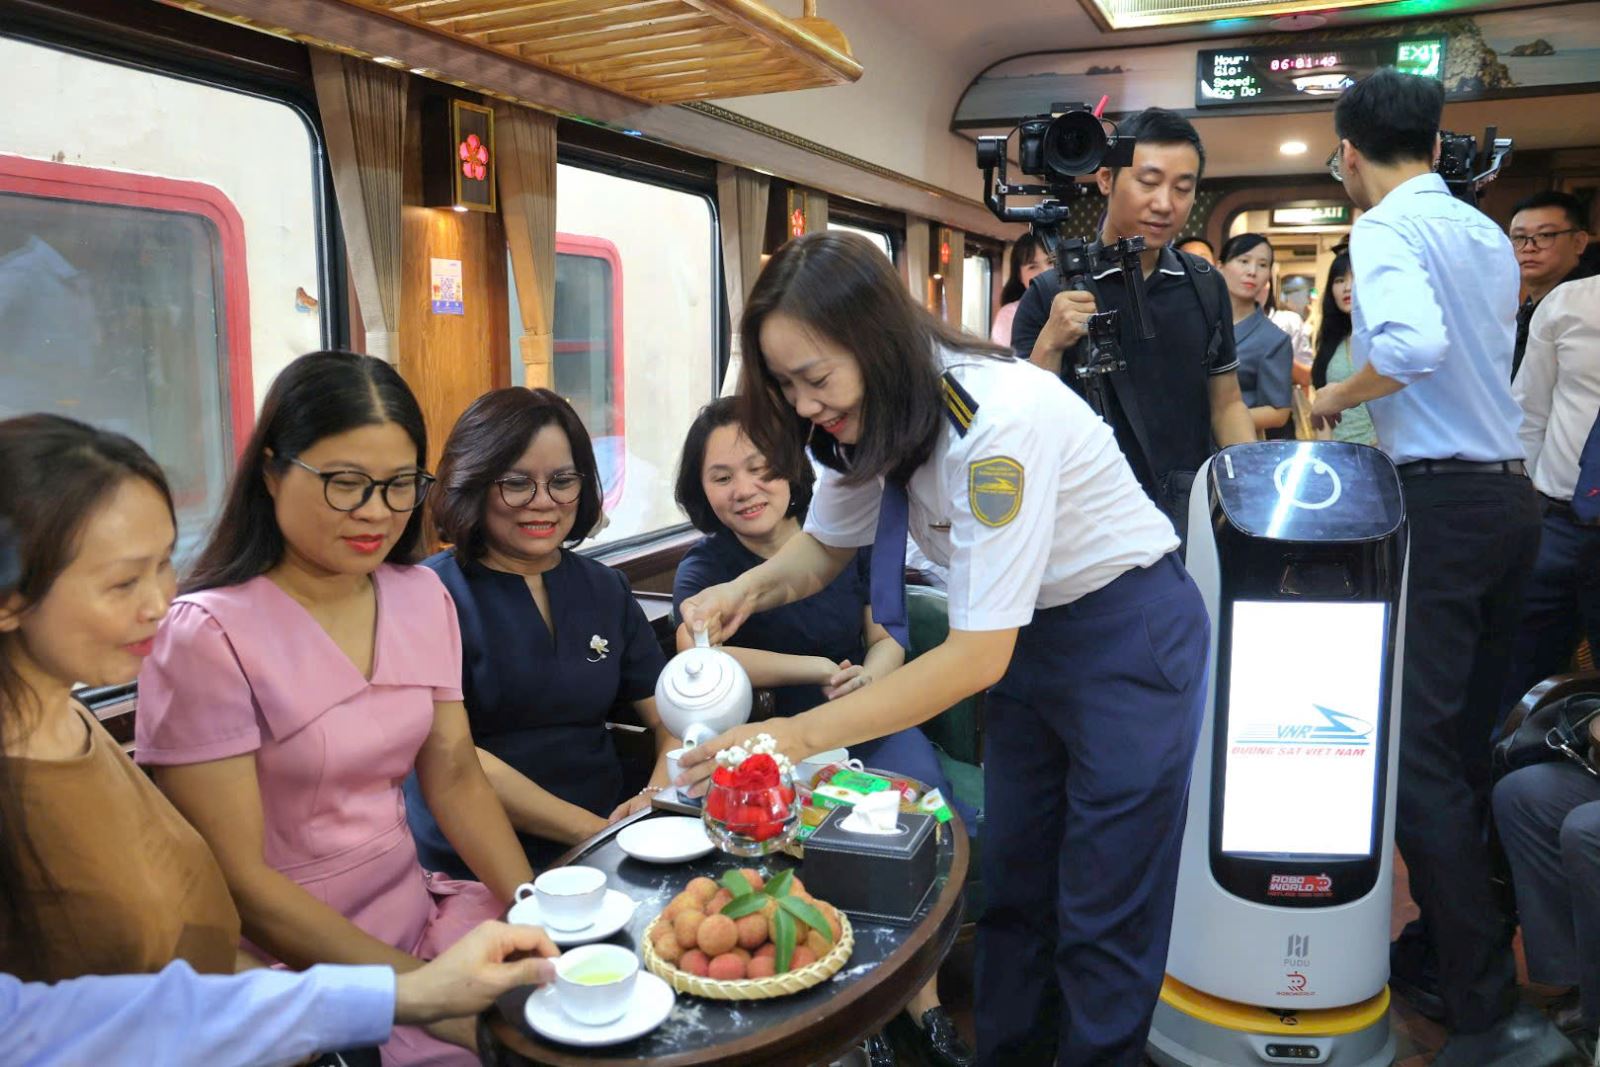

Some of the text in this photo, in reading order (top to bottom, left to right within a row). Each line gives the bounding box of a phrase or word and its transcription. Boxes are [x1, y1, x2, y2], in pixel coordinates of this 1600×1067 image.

[1399, 45, 1440, 60] EXIT
[1277, 725, 1313, 738] VNR
[1335, 748, 1365, 757] NAM
[1271, 875, 1304, 884] ROBO
[1269, 883, 1314, 891] WORLD
[1283, 958, 1310, 968] PUDU
